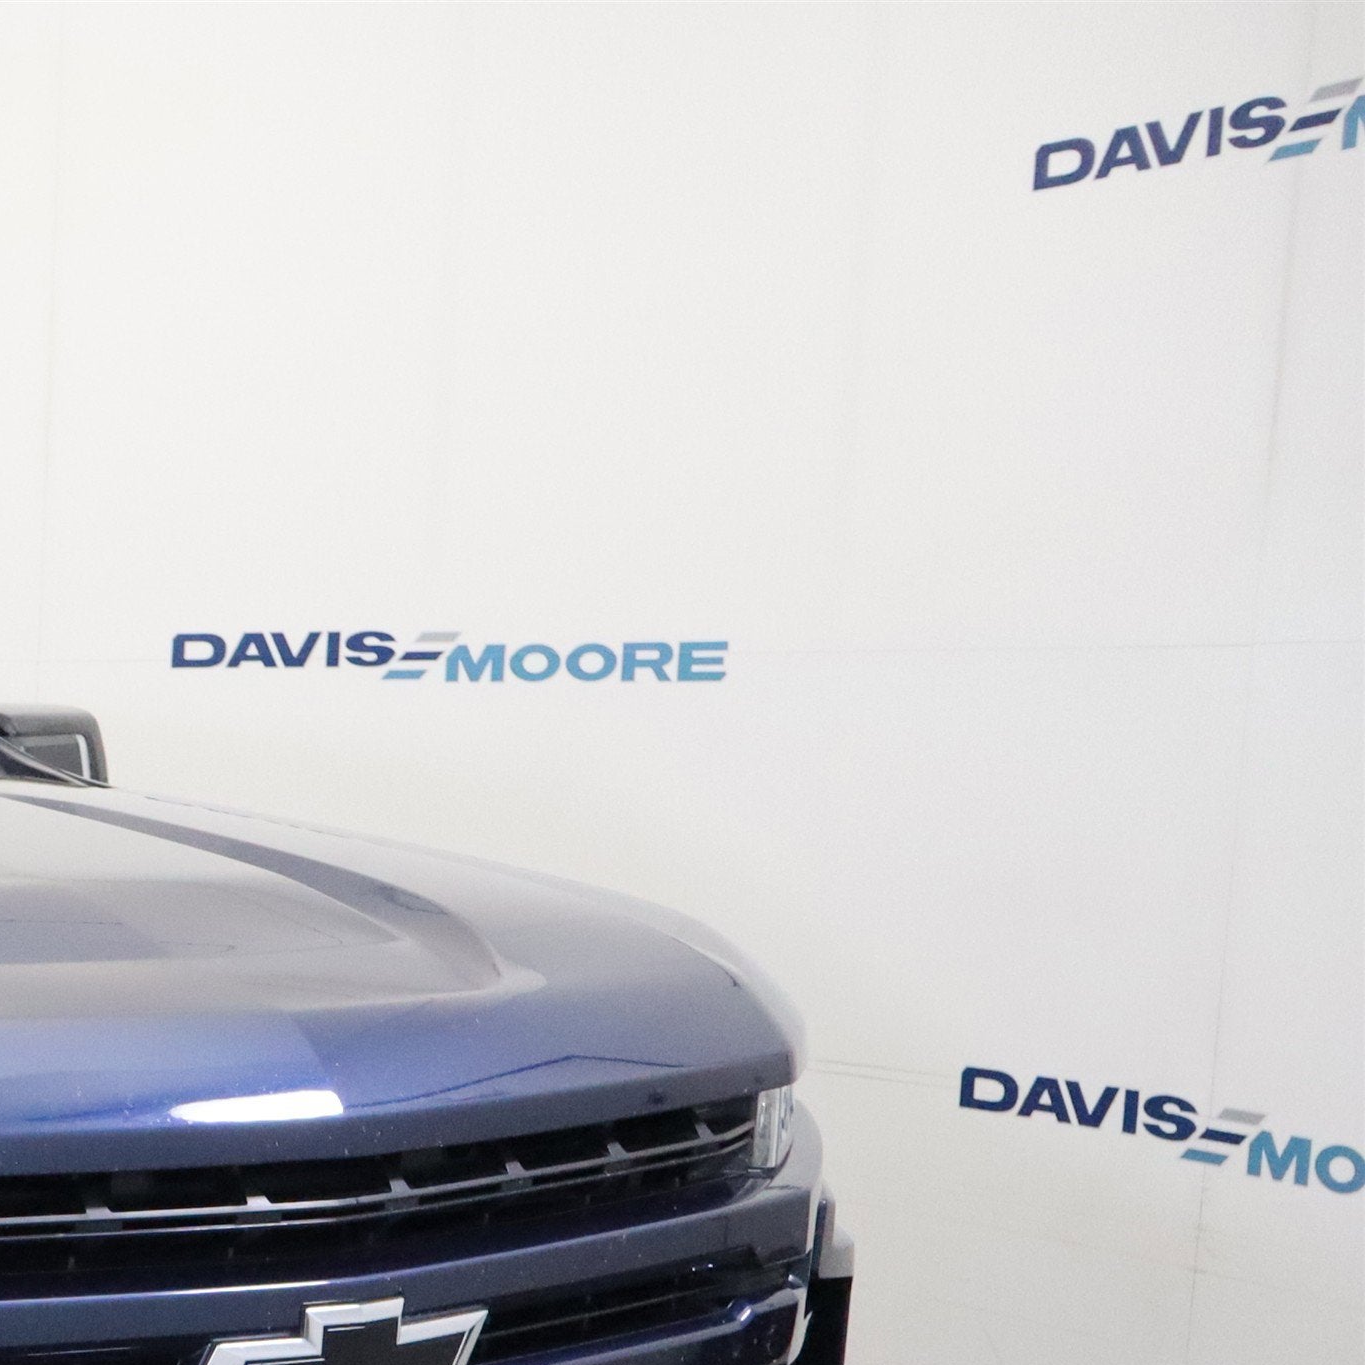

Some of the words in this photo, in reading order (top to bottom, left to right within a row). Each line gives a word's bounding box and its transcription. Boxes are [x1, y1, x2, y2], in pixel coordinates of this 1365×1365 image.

[1033, 96, 1287, 191] DAVIS
[170, 631, 397, 668] DAVIS
[445, 641, 728, 682] MOORE
[959, 1066, 1198, 1141] DAVIS
